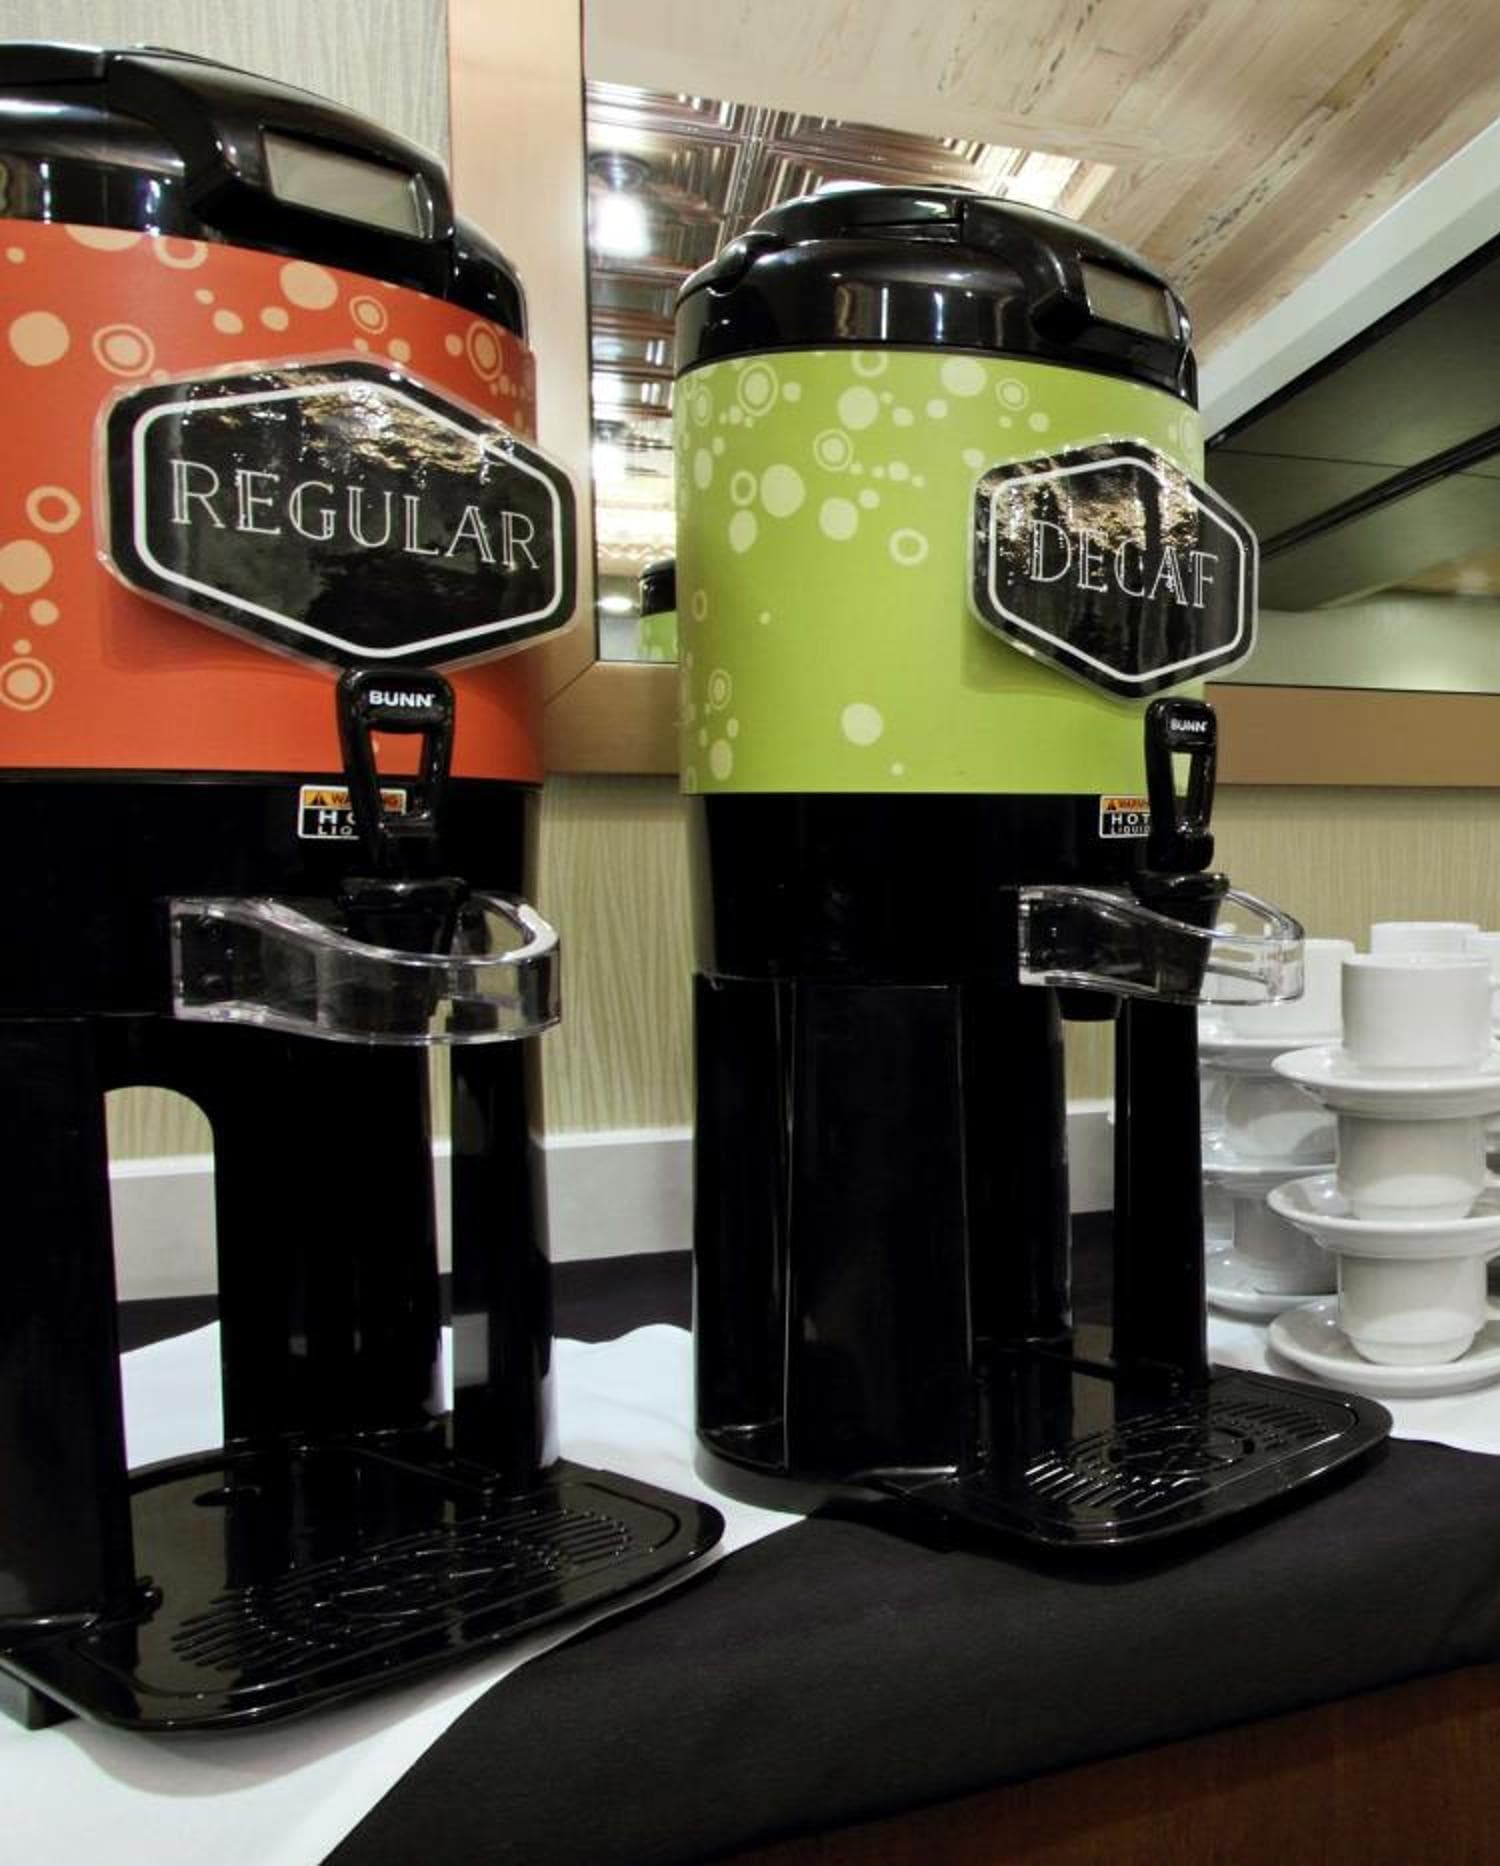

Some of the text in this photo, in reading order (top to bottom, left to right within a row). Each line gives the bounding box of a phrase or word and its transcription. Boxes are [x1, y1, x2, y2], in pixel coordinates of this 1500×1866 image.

[169, 458, 539, 571] REGULAR
[1029, 518, 1219, 608] DECAF
[1111, 813, 1151, 825] HOT
